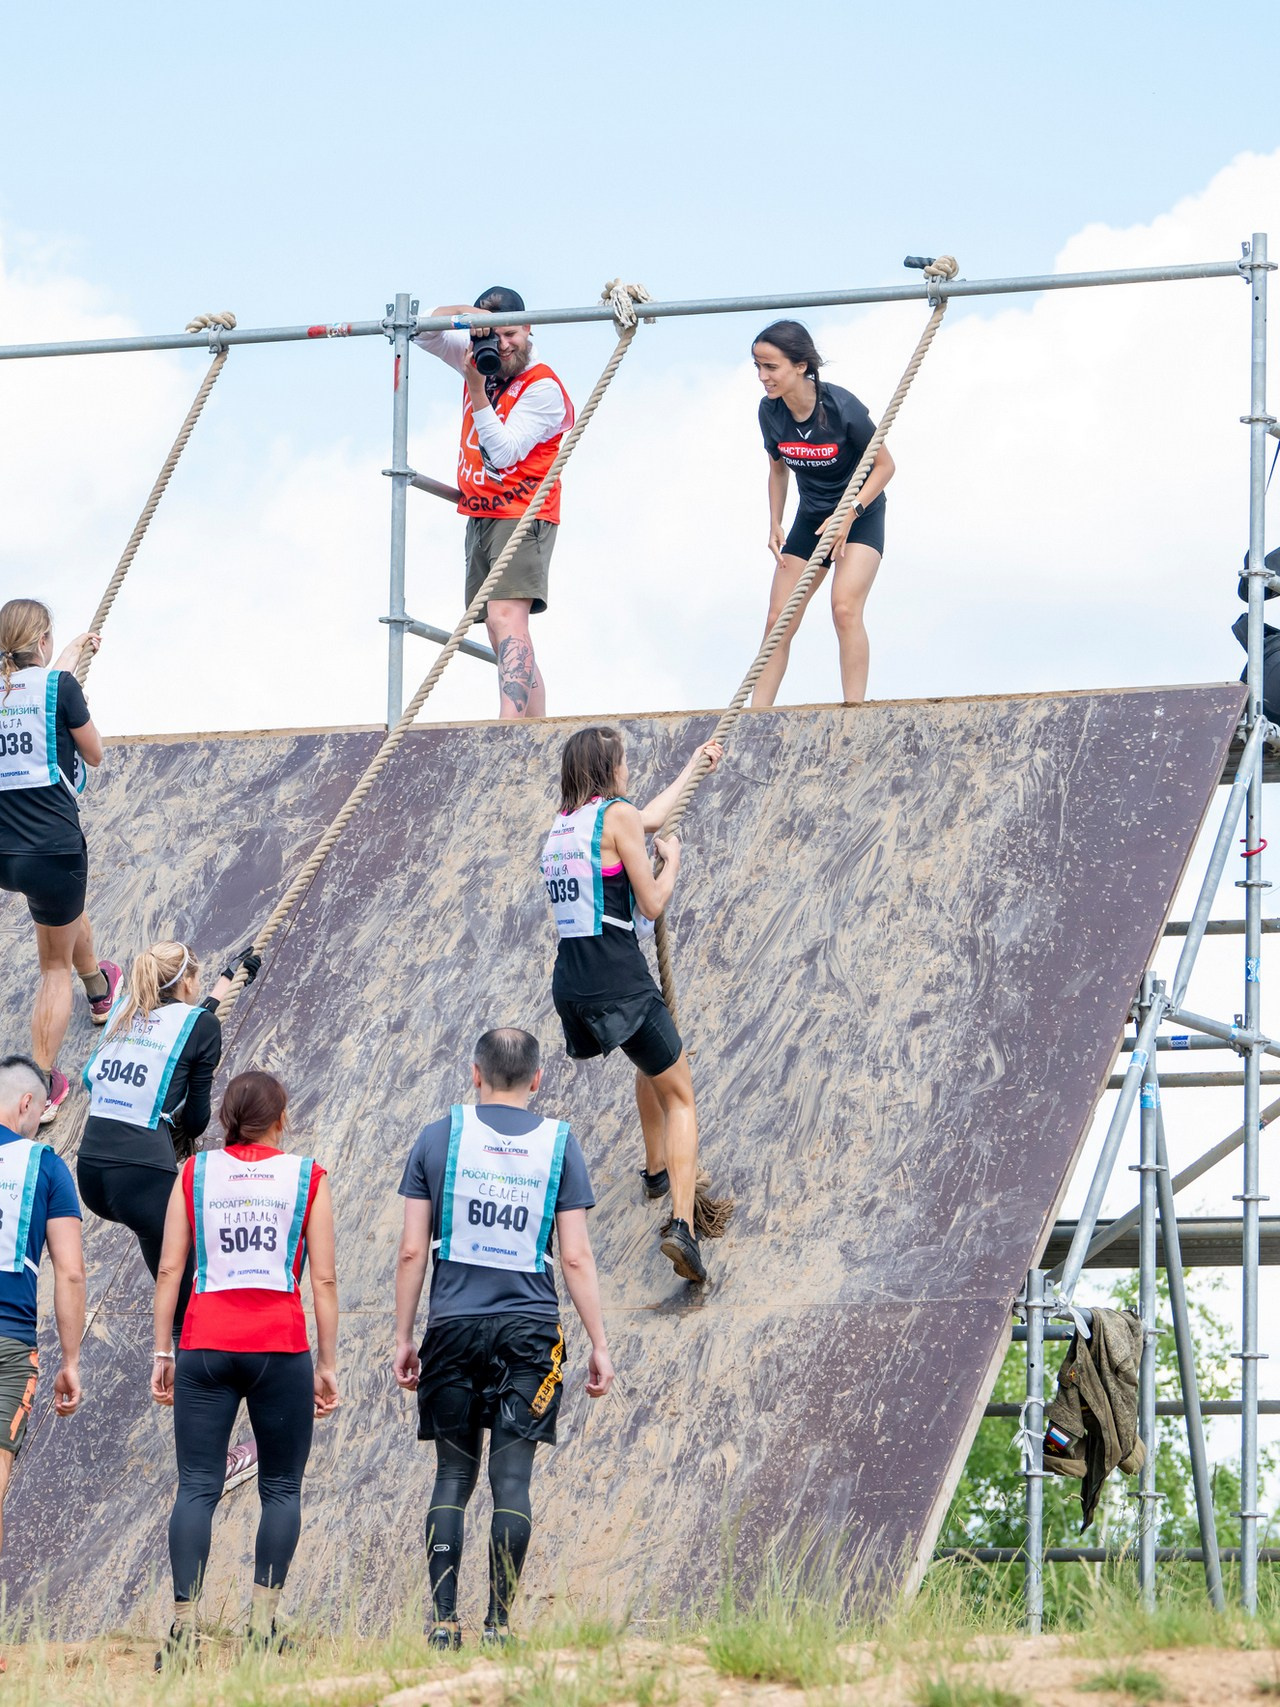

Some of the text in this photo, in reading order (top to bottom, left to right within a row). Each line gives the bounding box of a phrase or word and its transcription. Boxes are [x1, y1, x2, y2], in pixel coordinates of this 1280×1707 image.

[806, 457, 838, 467] ГЕРОЕВ
[0, 770, 30, 778] ГАЗПРОМБАНК
[96, 1059, 149, 1088] 5046
[104, 1097, 133, 1109] ГАЗПРОМБАНК
[484, 1144, 529, 1155] ГОНКА ГЕРОЕВ
[462, 1168, 542, 1189] РОСАГРОЛИЗИНГ
[209, 1198, 290, 1210] РОСАГРОЛИЗИНГ
[224, 1211, 278, 1226] НАТАЛЬЯ
[468, 1199, 529, 1233] 6040
[218, 1225, 277, 1254] 5043
[482, 1245, 518, 1257] ГАЗПРОМБАНК
